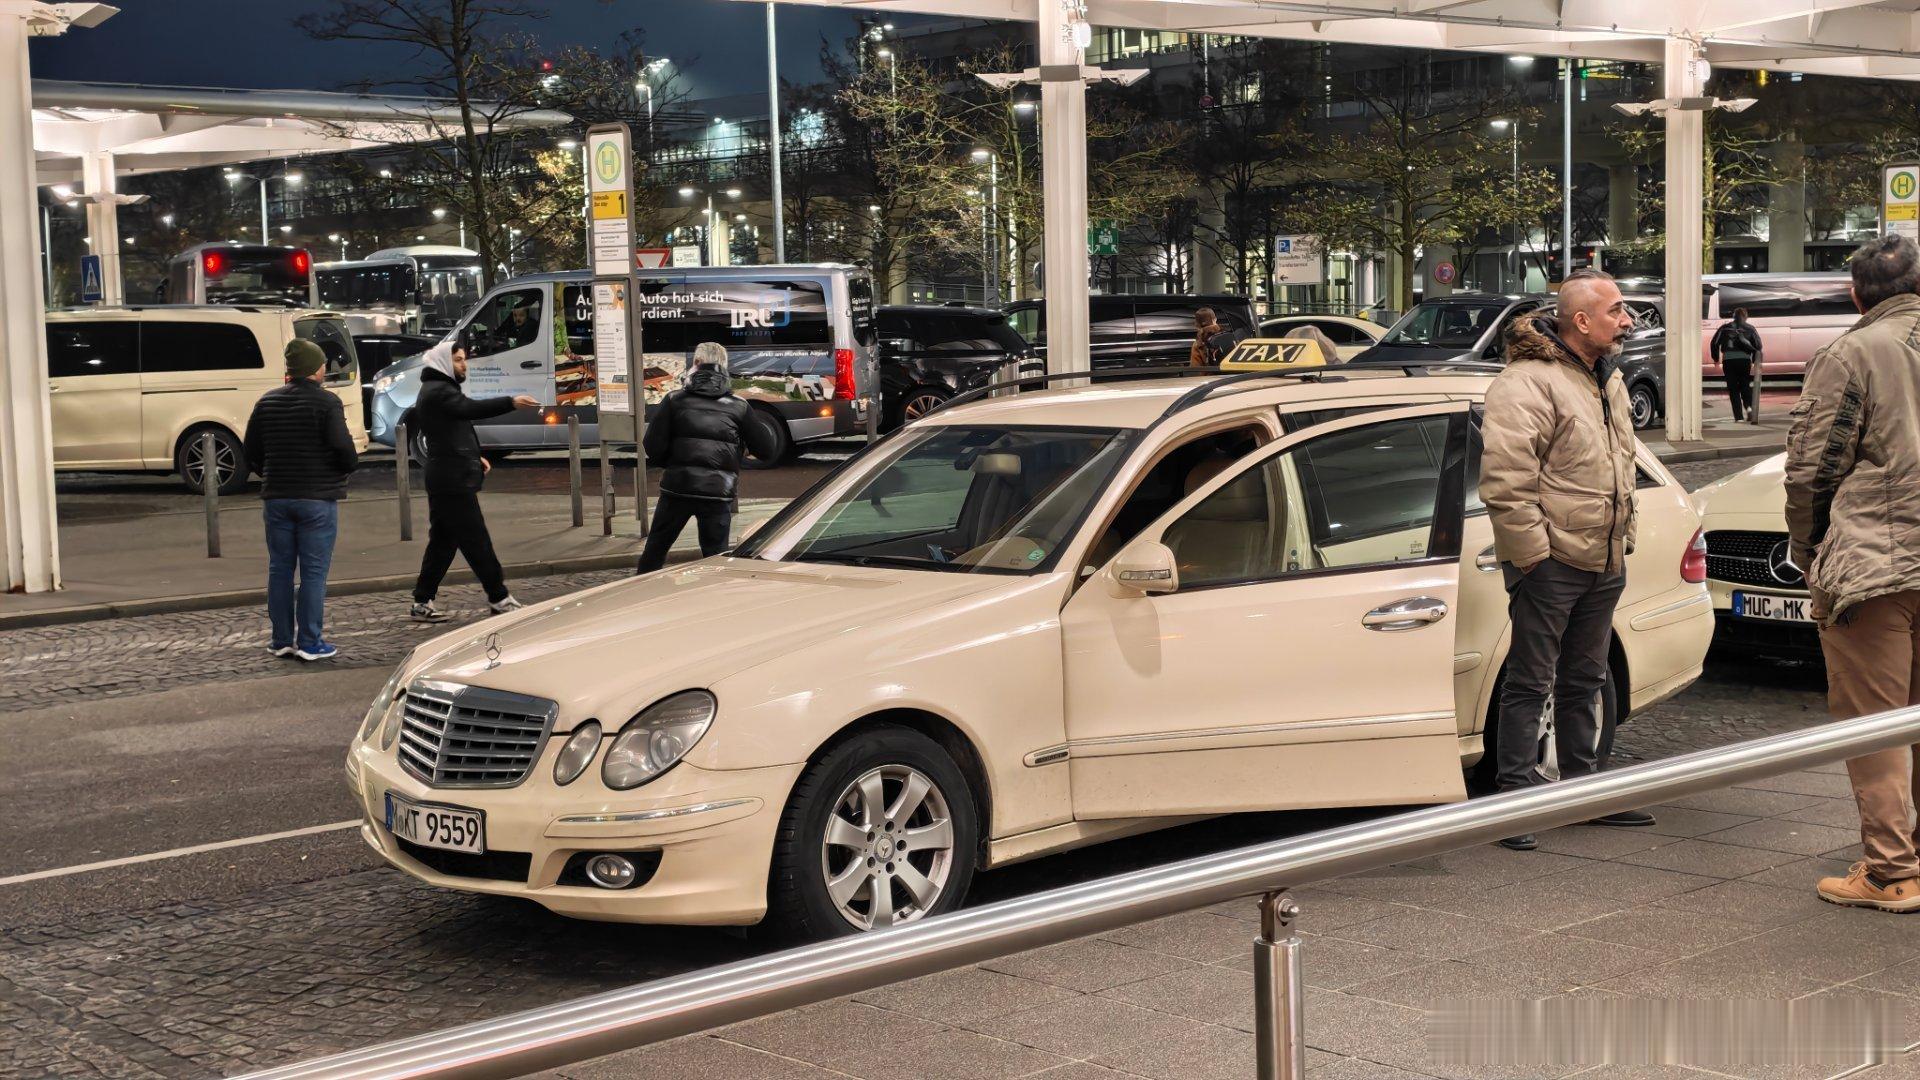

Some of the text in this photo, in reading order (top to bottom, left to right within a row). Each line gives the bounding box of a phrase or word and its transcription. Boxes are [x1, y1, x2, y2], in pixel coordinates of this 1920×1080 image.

[602, 151, 614, 175] H
[1898, 177, 1909, 193] H
[619, 193, 625, 214] 1
[1911, 209, 1917, 219] 2
[640, 293, 669, 304] Auto
[672, 292, 694, 303] hat
[698, 291, 724, 302] sich
[642, 307, 685, 319] rdient.
[1237, 345, 1304, 361] TAXI
[1743, 596, 1772, 616] MUC
[1783, 600, 1804, 619] MK
[404, 808, 420, 839] KT
[426, 812, 479, 848] 9559
